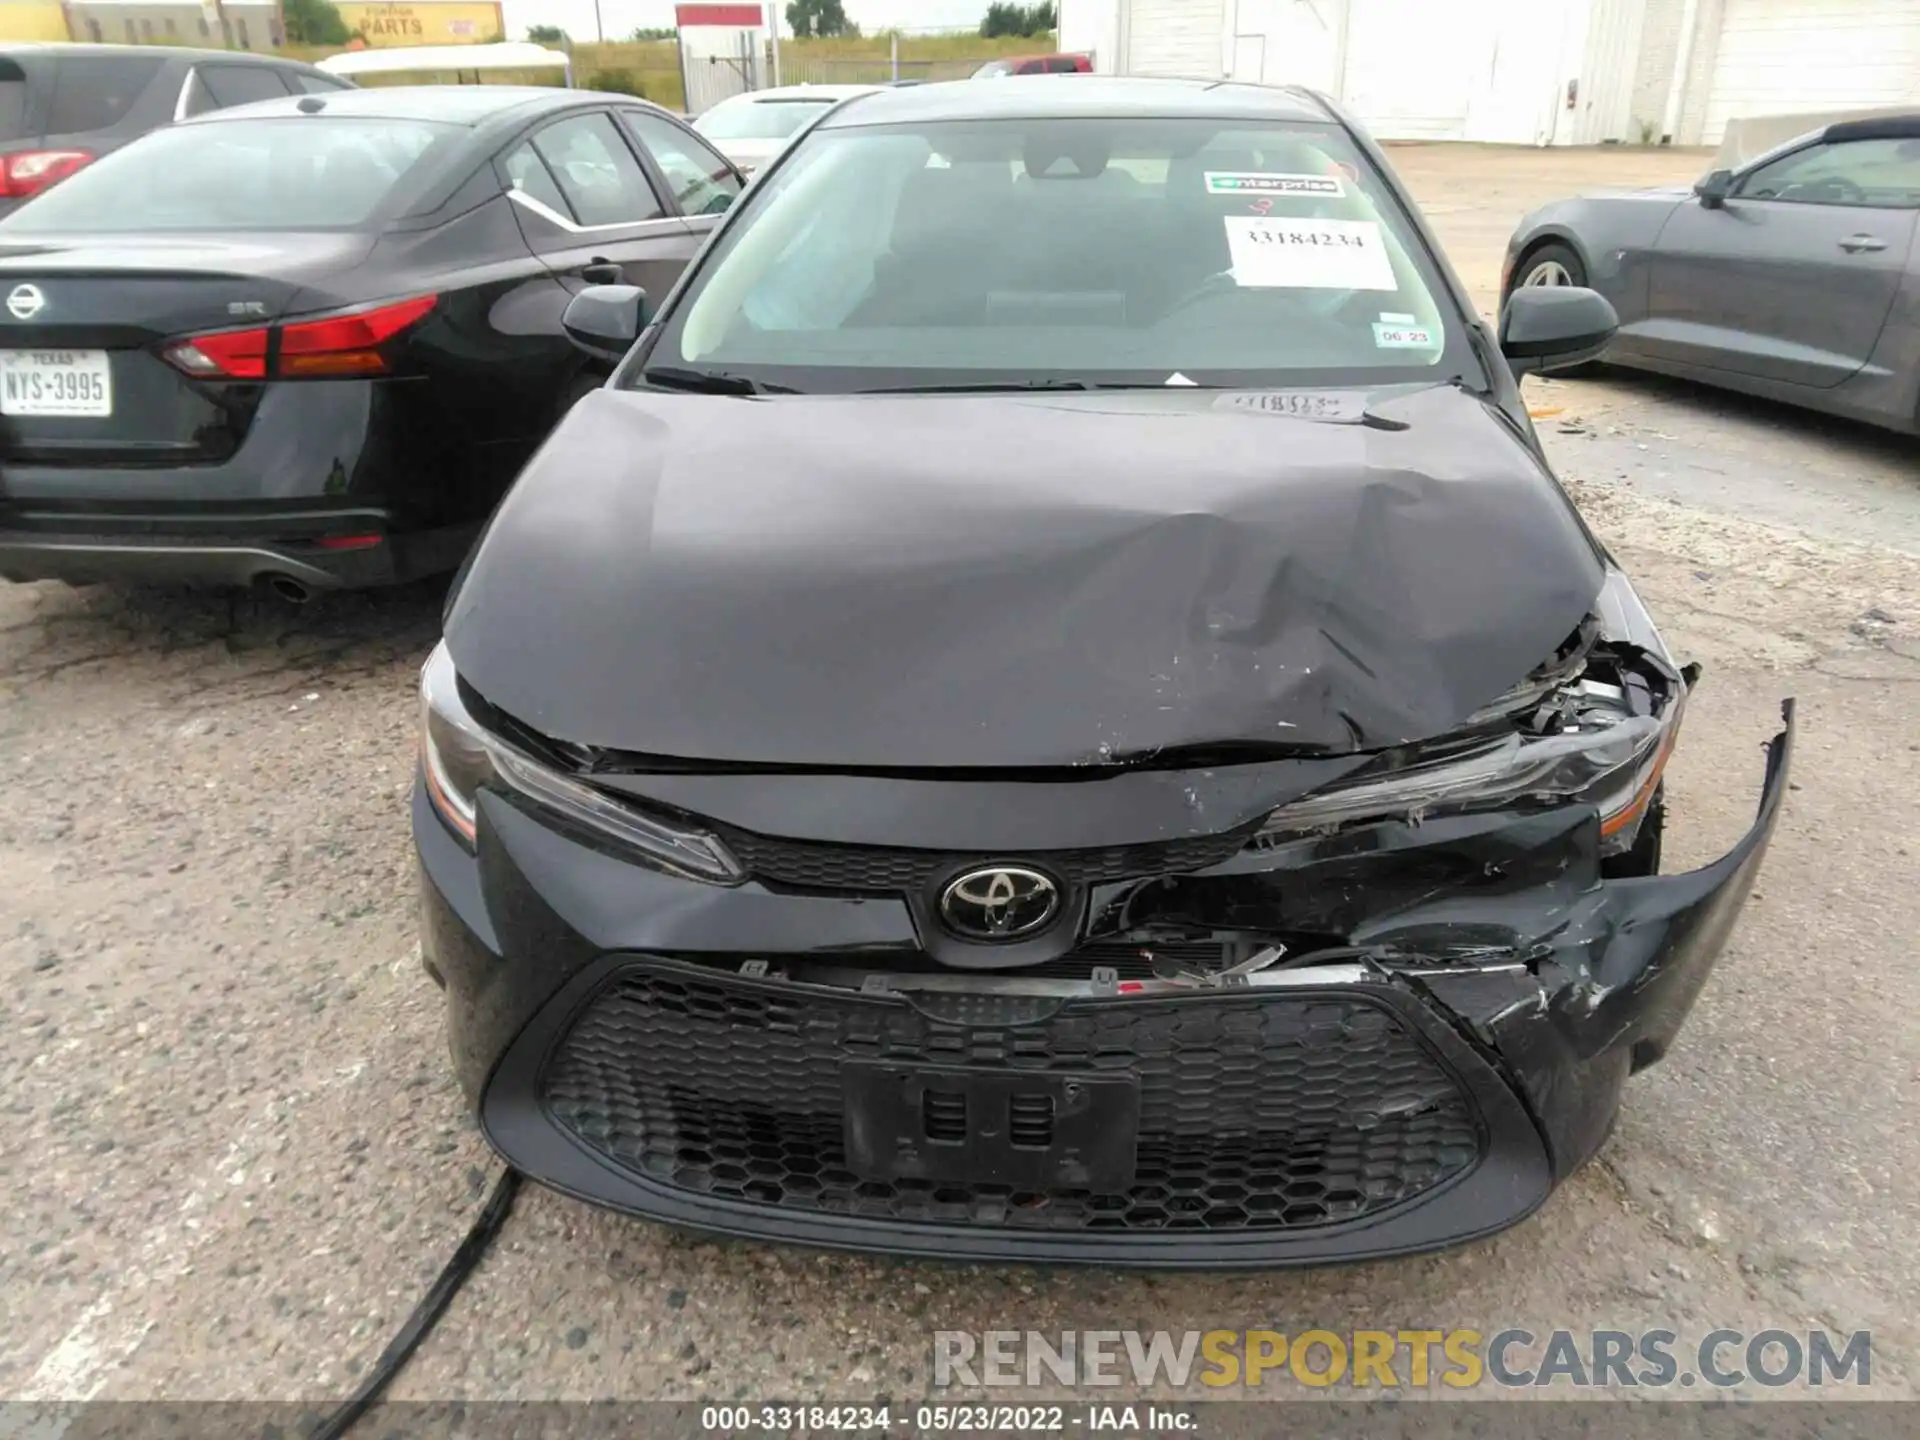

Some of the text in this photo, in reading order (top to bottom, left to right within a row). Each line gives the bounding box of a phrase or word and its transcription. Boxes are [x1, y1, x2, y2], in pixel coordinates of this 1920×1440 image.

[360, 18, 422, 35] PARTS
[1248, 230, 1364, 248] 33184234
[227, 302, 266, 314] SR
[1383, 331, 1428, 342] 06 23
[31, 352, 74, 365] TEXAS
